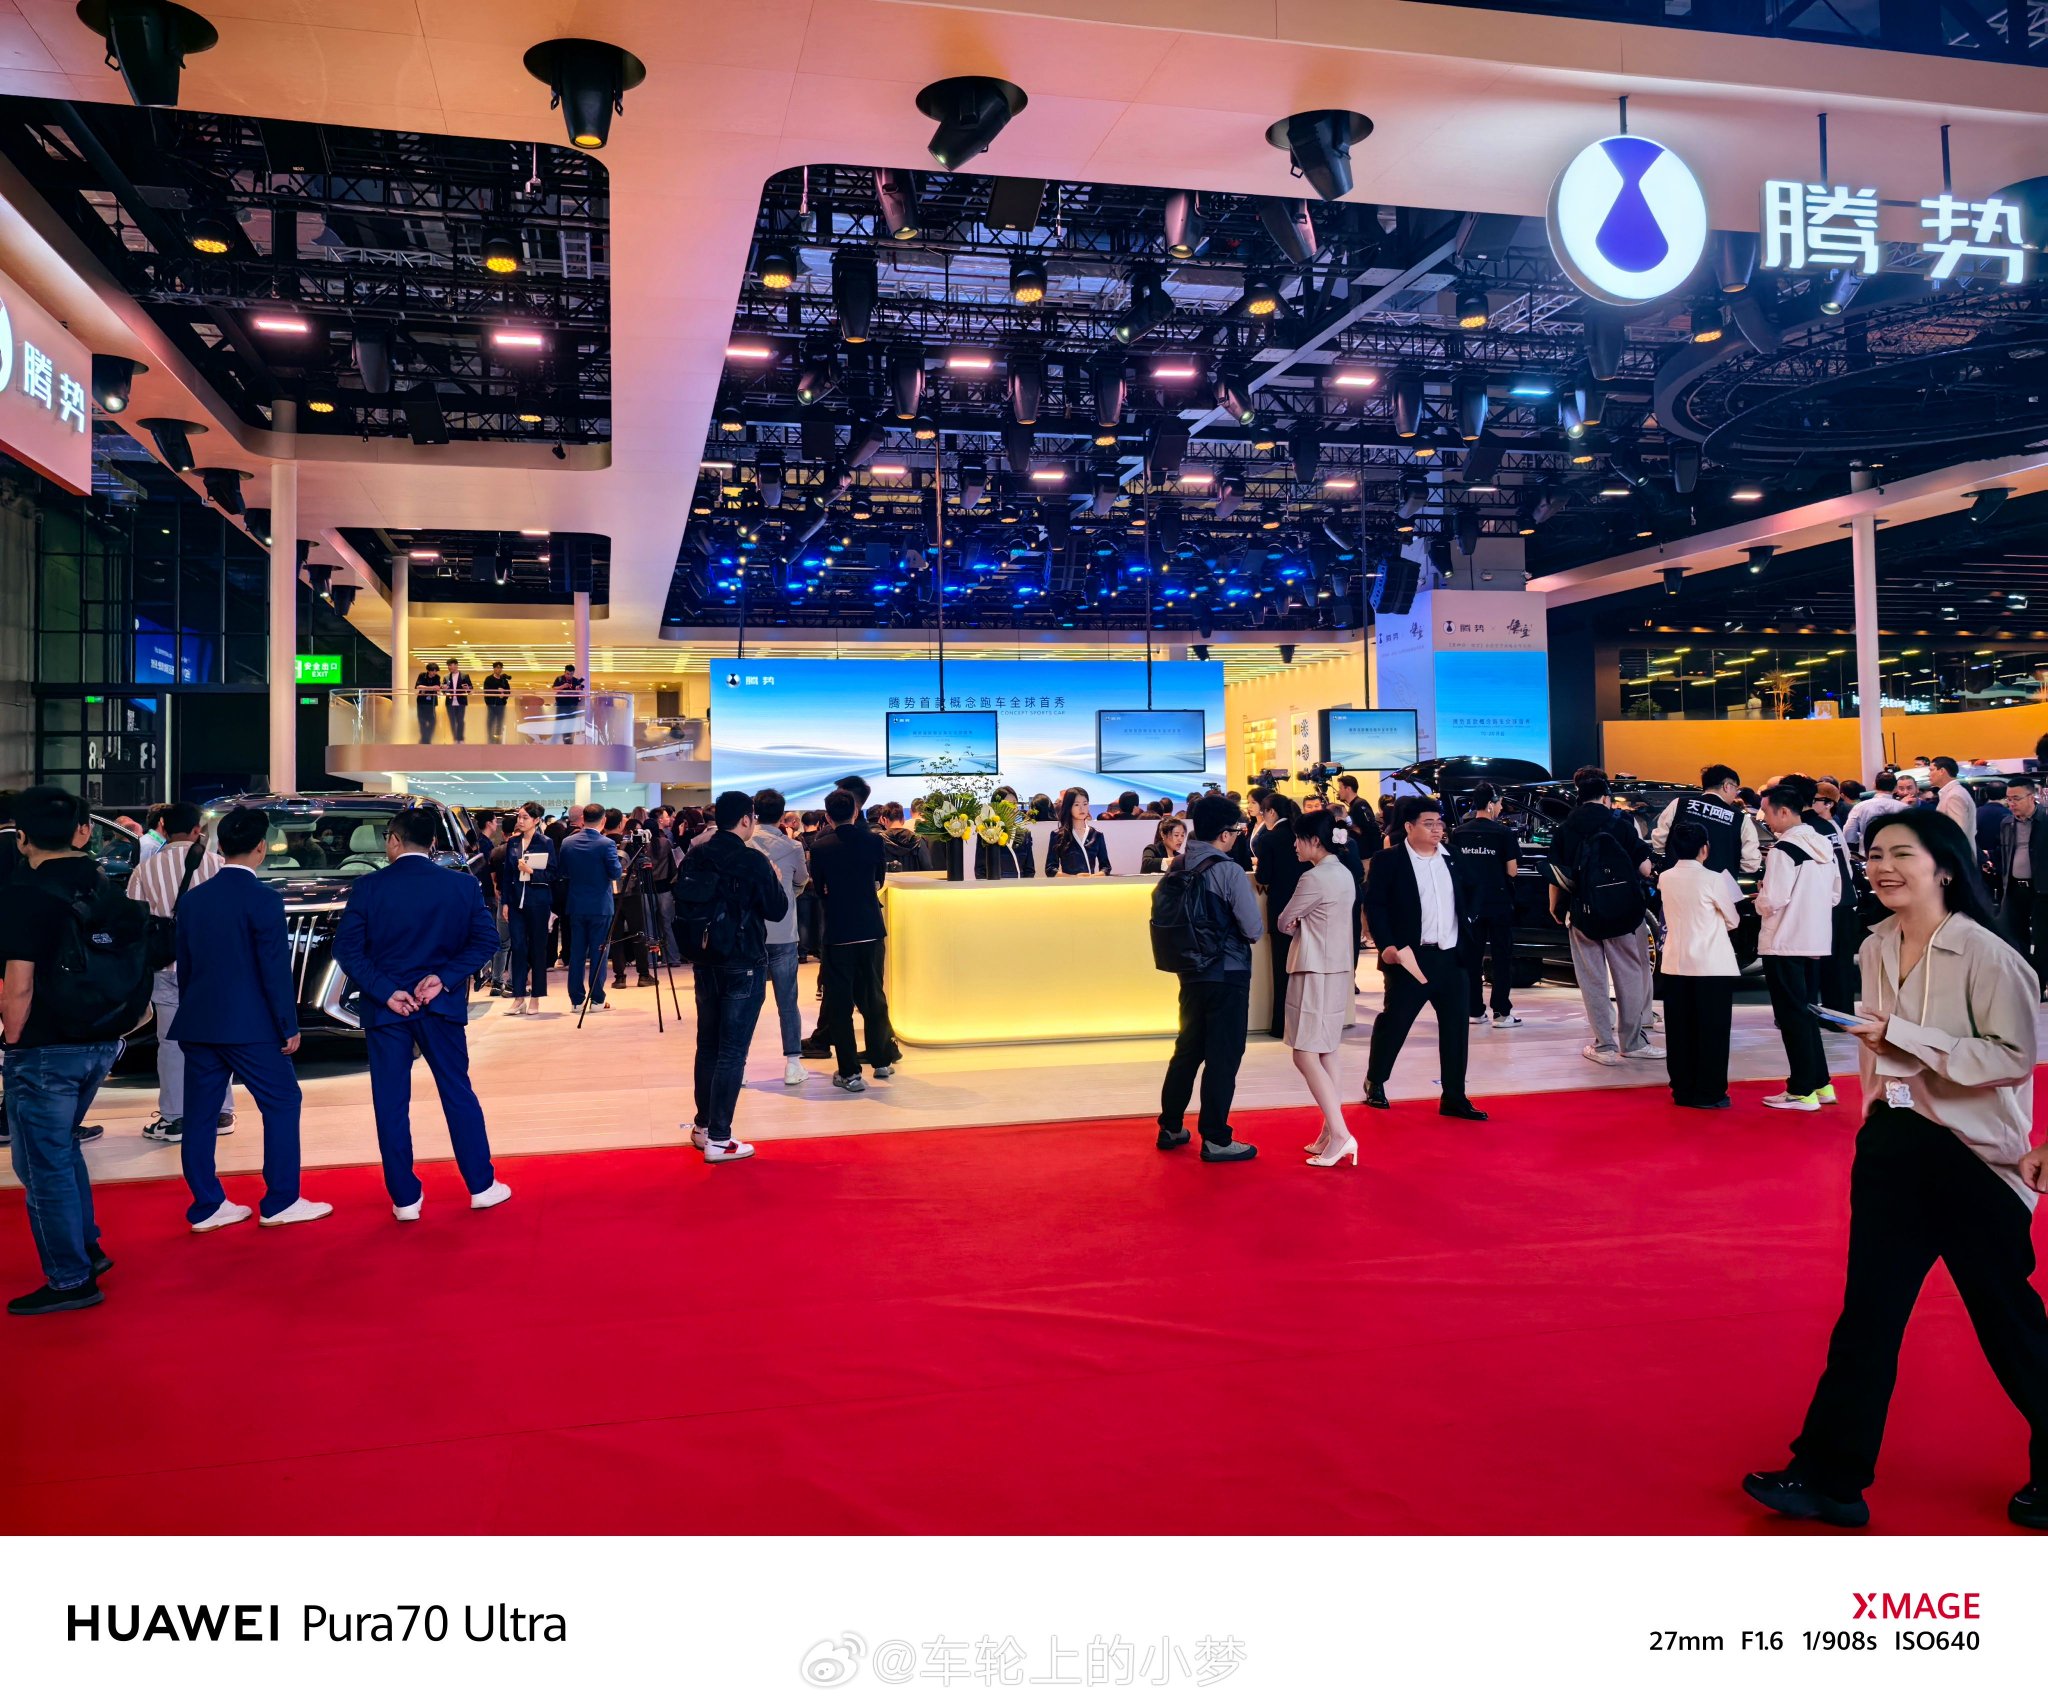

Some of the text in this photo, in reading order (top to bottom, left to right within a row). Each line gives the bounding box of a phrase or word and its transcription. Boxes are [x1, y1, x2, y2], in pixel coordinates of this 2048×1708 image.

[1764, 180, 2025, 284] 腾势
[24, 341, 85, 433] 腾势
[304, 662, 337, 670] 安全出口
[1686, 799, 1735, 823] 天下网商
[1461, 847, 1496, 856] MetaLive
